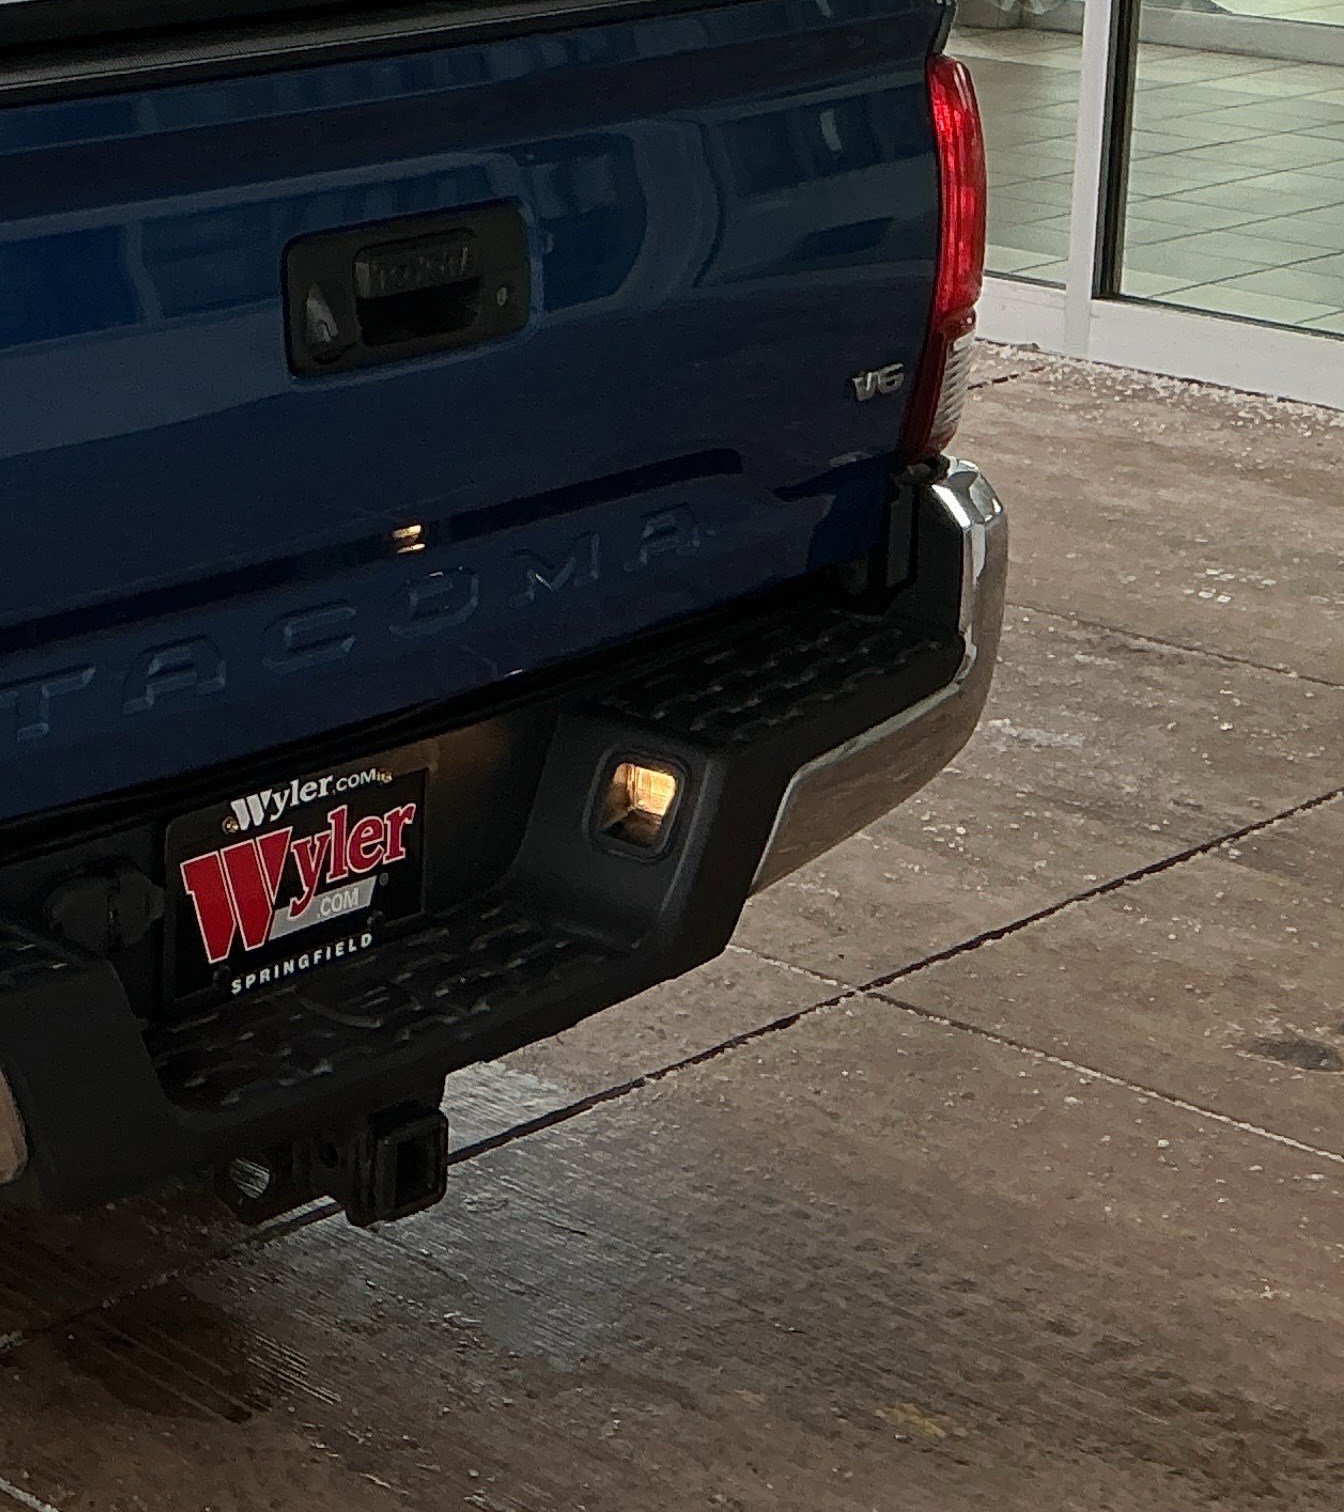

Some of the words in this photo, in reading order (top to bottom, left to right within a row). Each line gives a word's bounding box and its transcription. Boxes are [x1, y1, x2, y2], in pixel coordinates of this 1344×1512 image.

[852, 362, 905, 401] V6
[180, 803, 416, 964] Wyler
[317, 888, 360, 919] .COM
[231, 933, 373, 994] SPRINGFIELD
